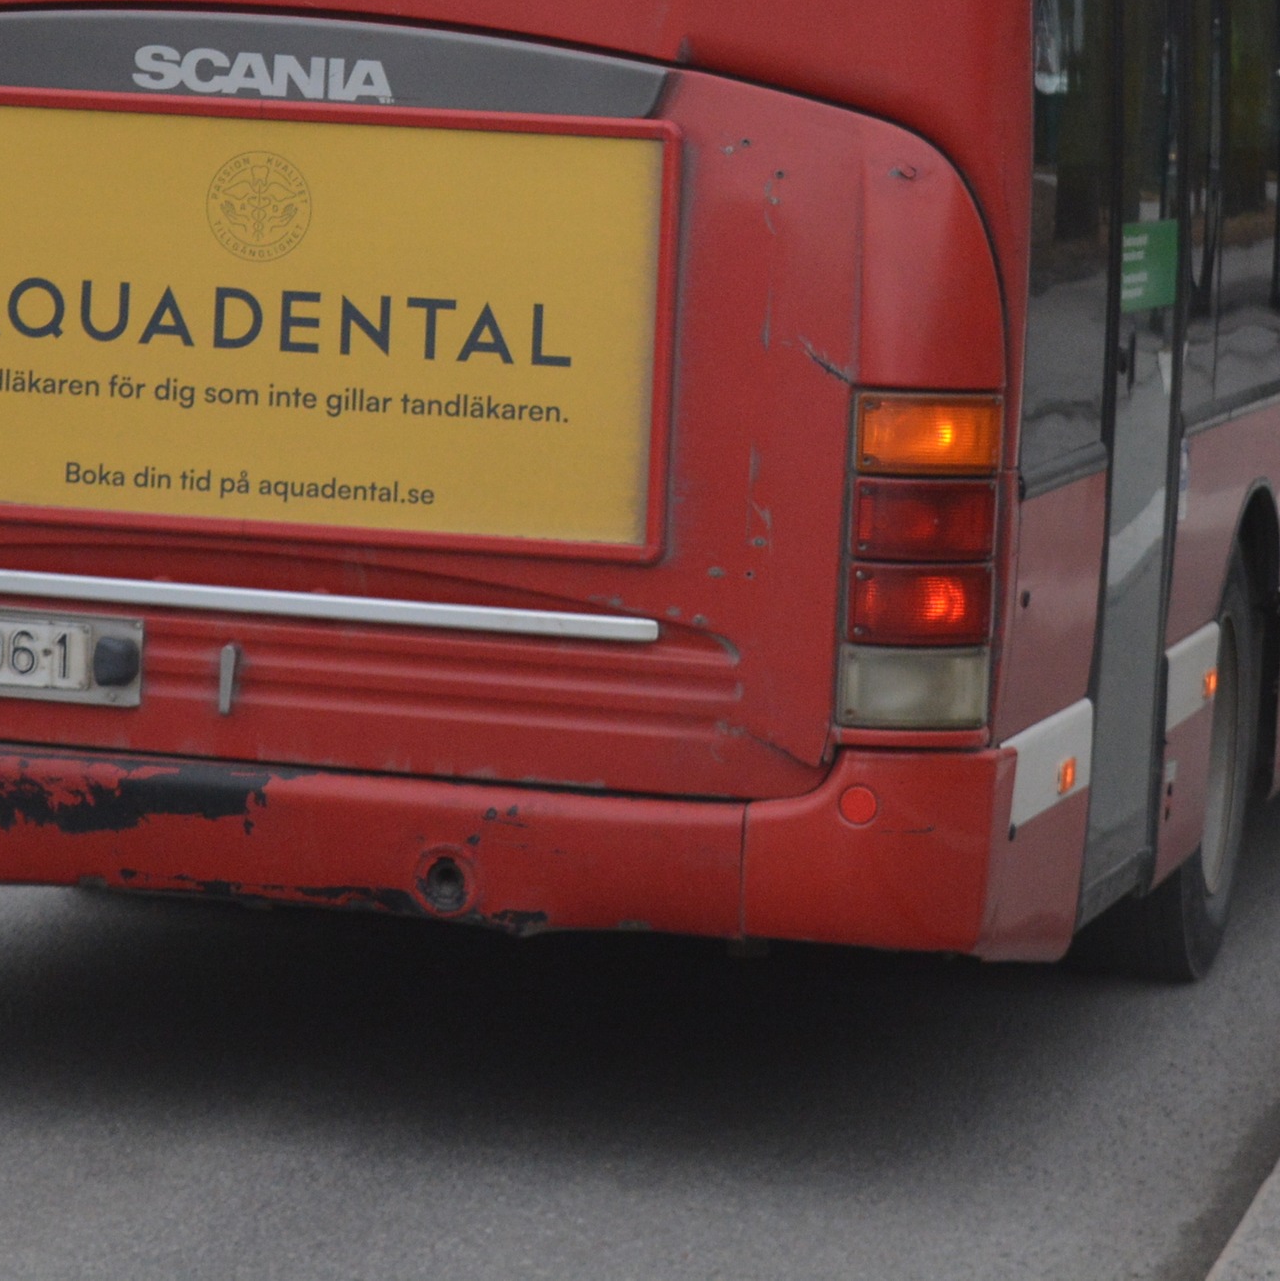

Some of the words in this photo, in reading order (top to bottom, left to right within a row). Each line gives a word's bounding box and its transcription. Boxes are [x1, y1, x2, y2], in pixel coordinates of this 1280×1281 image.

[132, 44, 393, 101] SCANIA
[211, 157, 250, 200] PASSION
[266, 157, 308, 204] KVALITET
[109, 375, 147, 400] för
[153, 378, 195, 409] dig
[204, 387, 258, 405] som
[268, 384, 317, 409] inte
[325, 388, 392, 418] gillar
[401, 394, 569, 423] tandläkaren.
[65, 462, 125, 487] Boka
[134, 466, 171, 490] din
[179, 468, 211, 491] tid
[220, 470, 249, 499] på
[258, 477, 435, 505] aquadental.se
